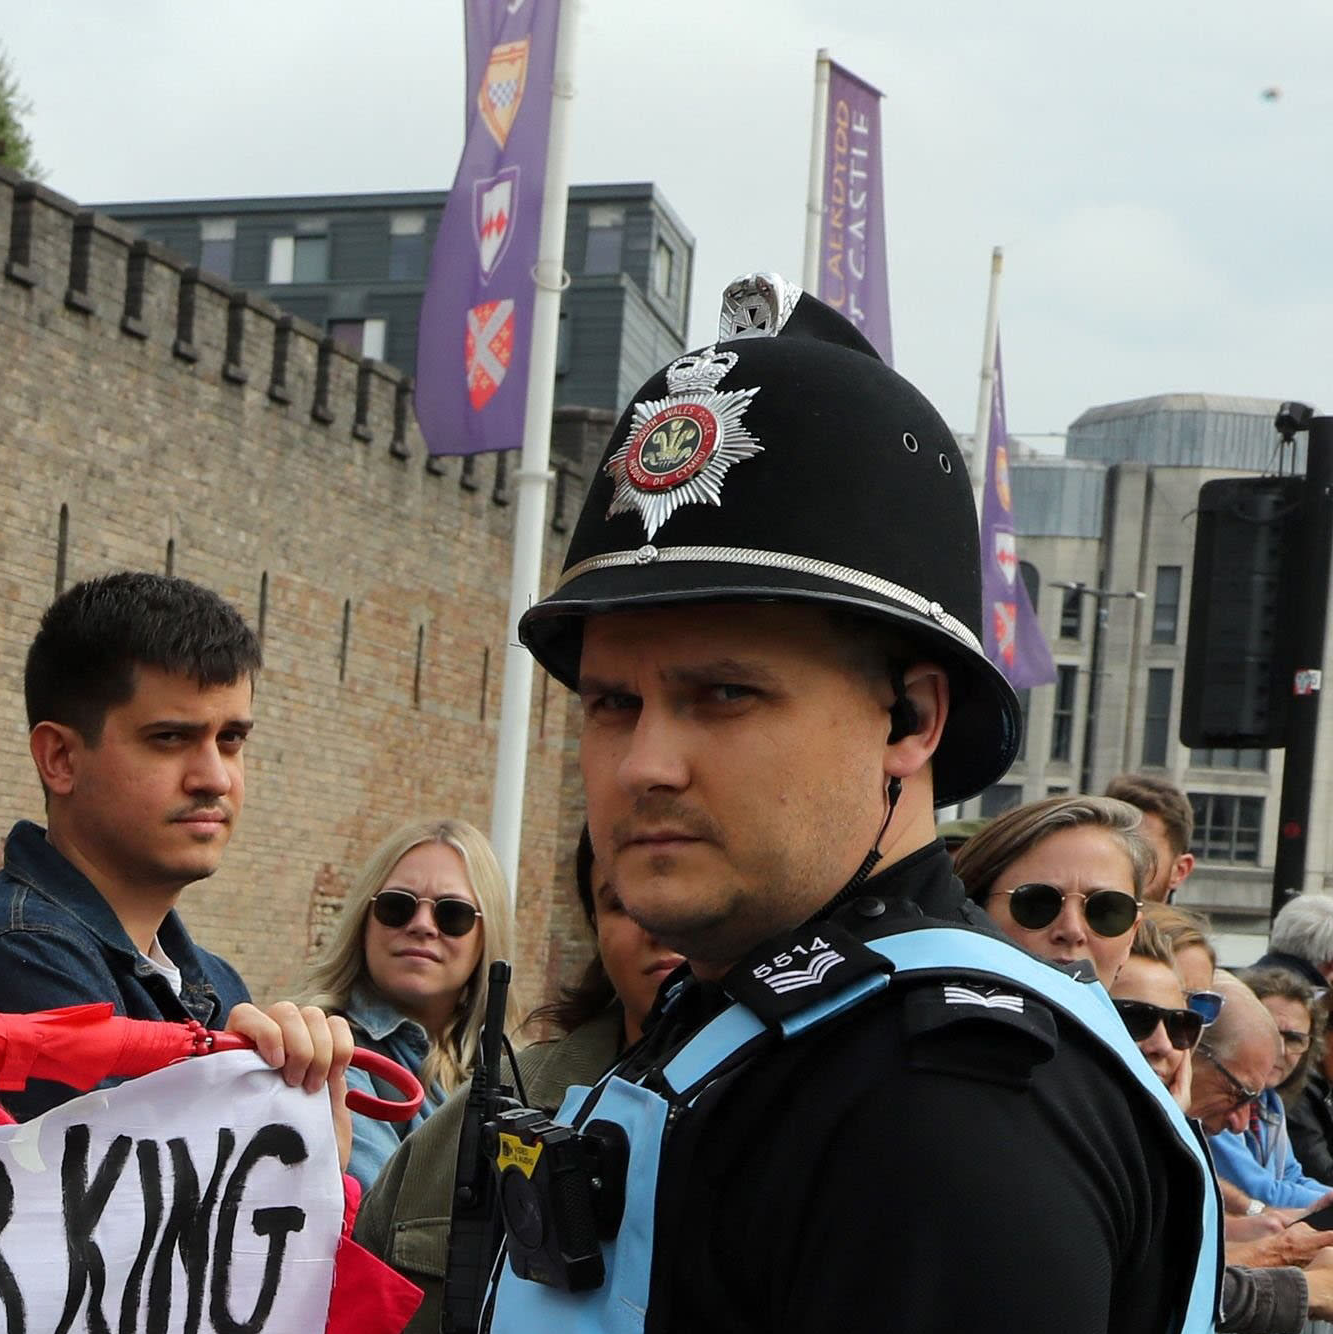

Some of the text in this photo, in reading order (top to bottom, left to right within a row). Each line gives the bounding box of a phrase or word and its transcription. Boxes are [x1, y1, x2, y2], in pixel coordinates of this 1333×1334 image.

[663, 405, 694, 419] WALES
[652, 475, 666, 487] DE
[675, 450, 706, 479] CYMRU
[752, 936, 831, 979] 5514
